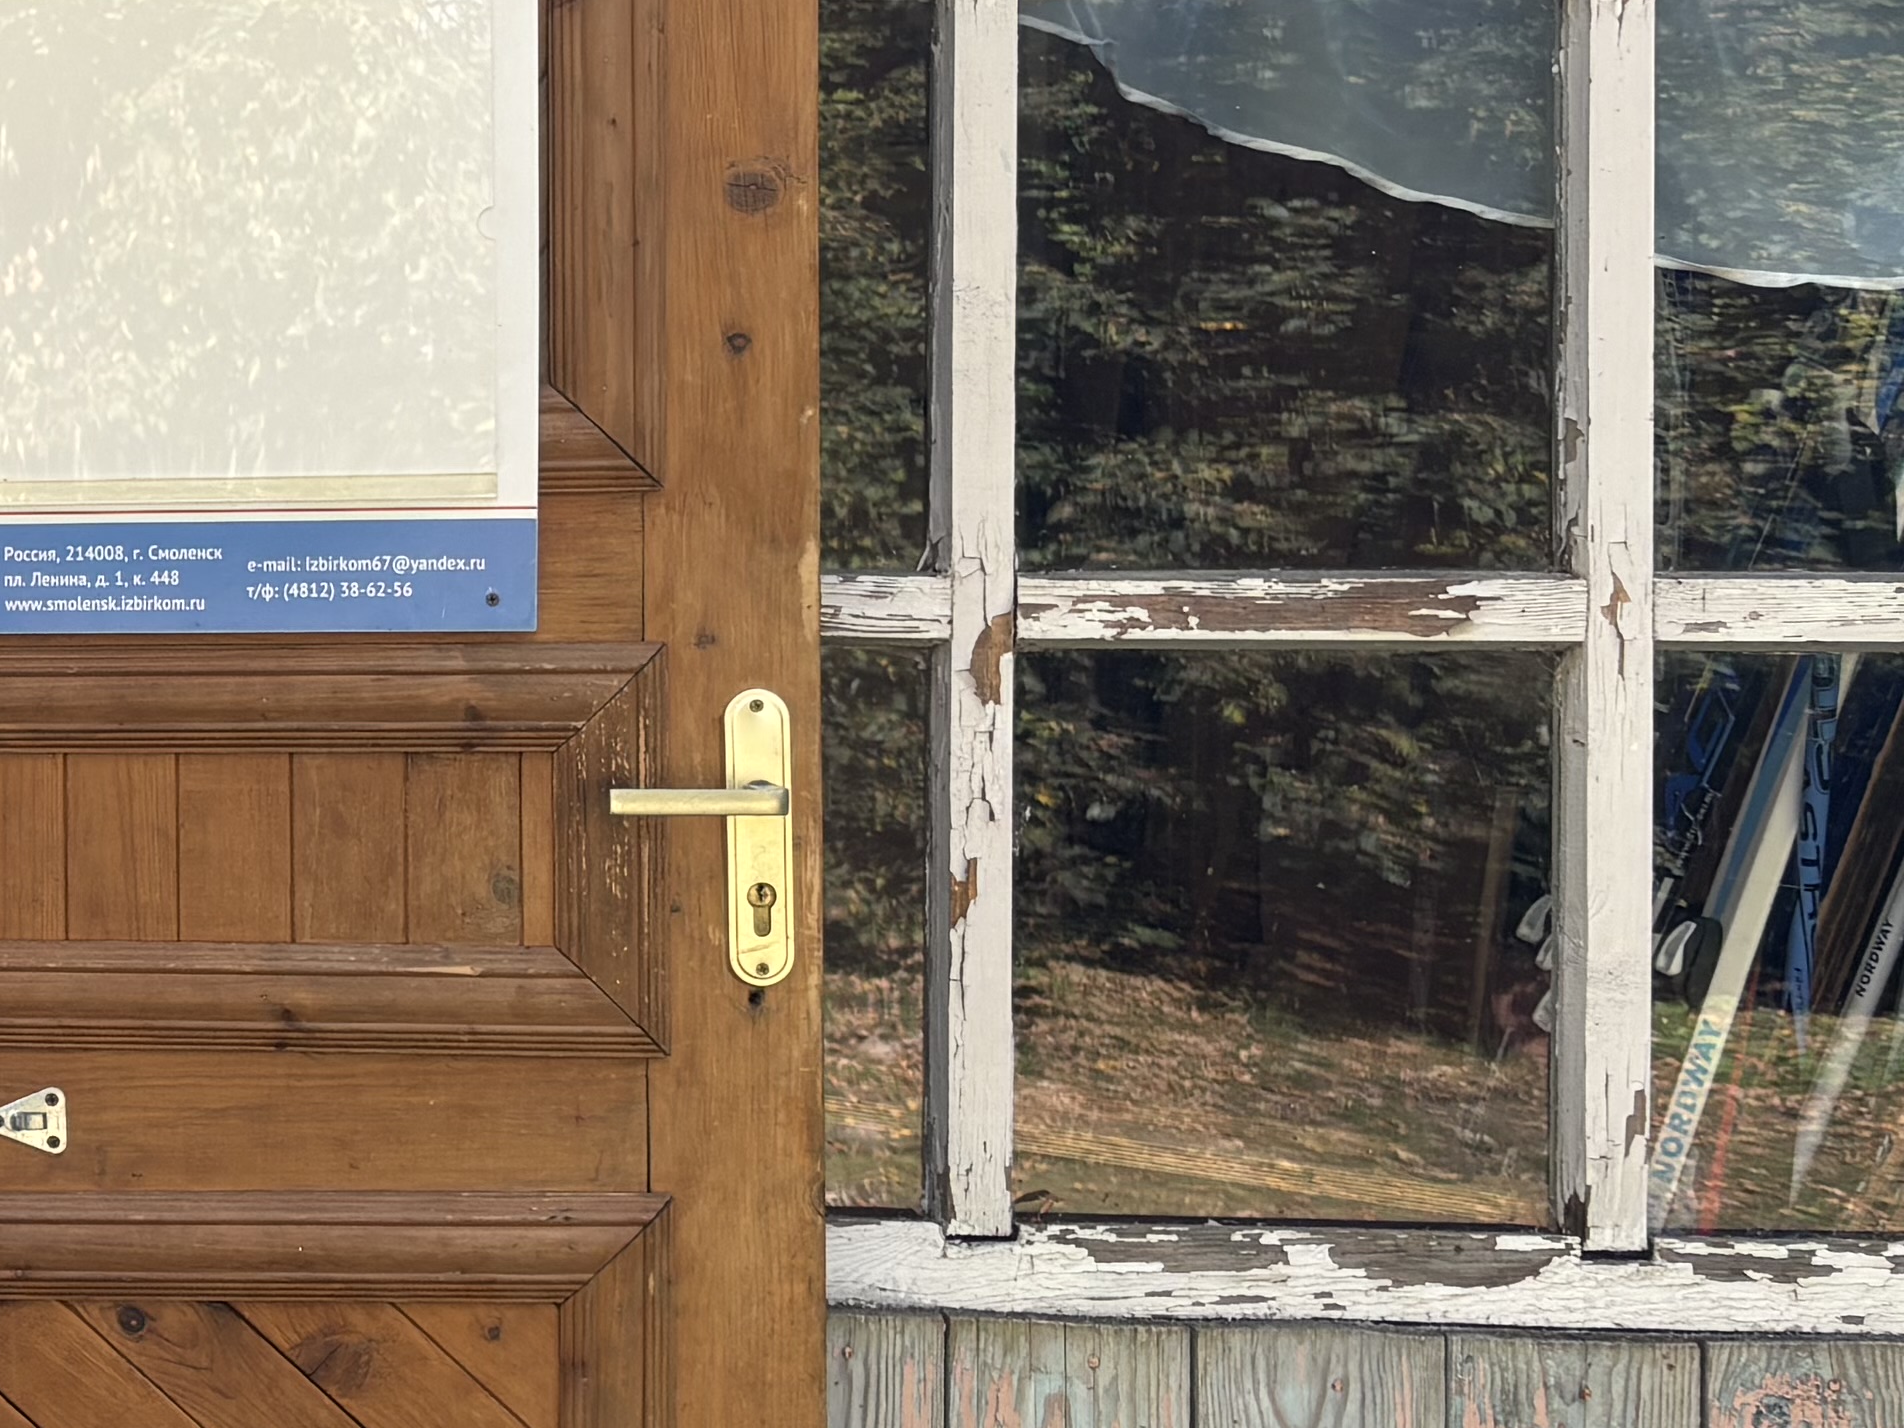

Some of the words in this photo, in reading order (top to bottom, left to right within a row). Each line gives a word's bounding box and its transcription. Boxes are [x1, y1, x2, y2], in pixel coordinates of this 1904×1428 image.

[4, 546, 60, 563] Россия,
[66, 546, 128, 562] 214008,
[133, 549, 143, 560] г.
[148, 545, 222, 560] Смоленск
[247, 557, 301, 572] e-mail:
[4, 575, 26, 586] пл.
[30, 572, 91, 588] Ленина,
[95, 574, 109, 587] д.
[115, 571, 128, 588] 1,
[133, 574, 145, 585] к.
[150, 571, 179, 585] 448
[247, 582, 278, 601] т/ф:
[284, 582, 335, 601] (4812)
[341, 582, 412, 597] 38-62-56
[5, 596, 204, 611] www.smolensk.izbirkom.ru
[1855, 919, 1894, 997] NORDWAY
[1653, 1018, 1722, 1184] NORDWAY
